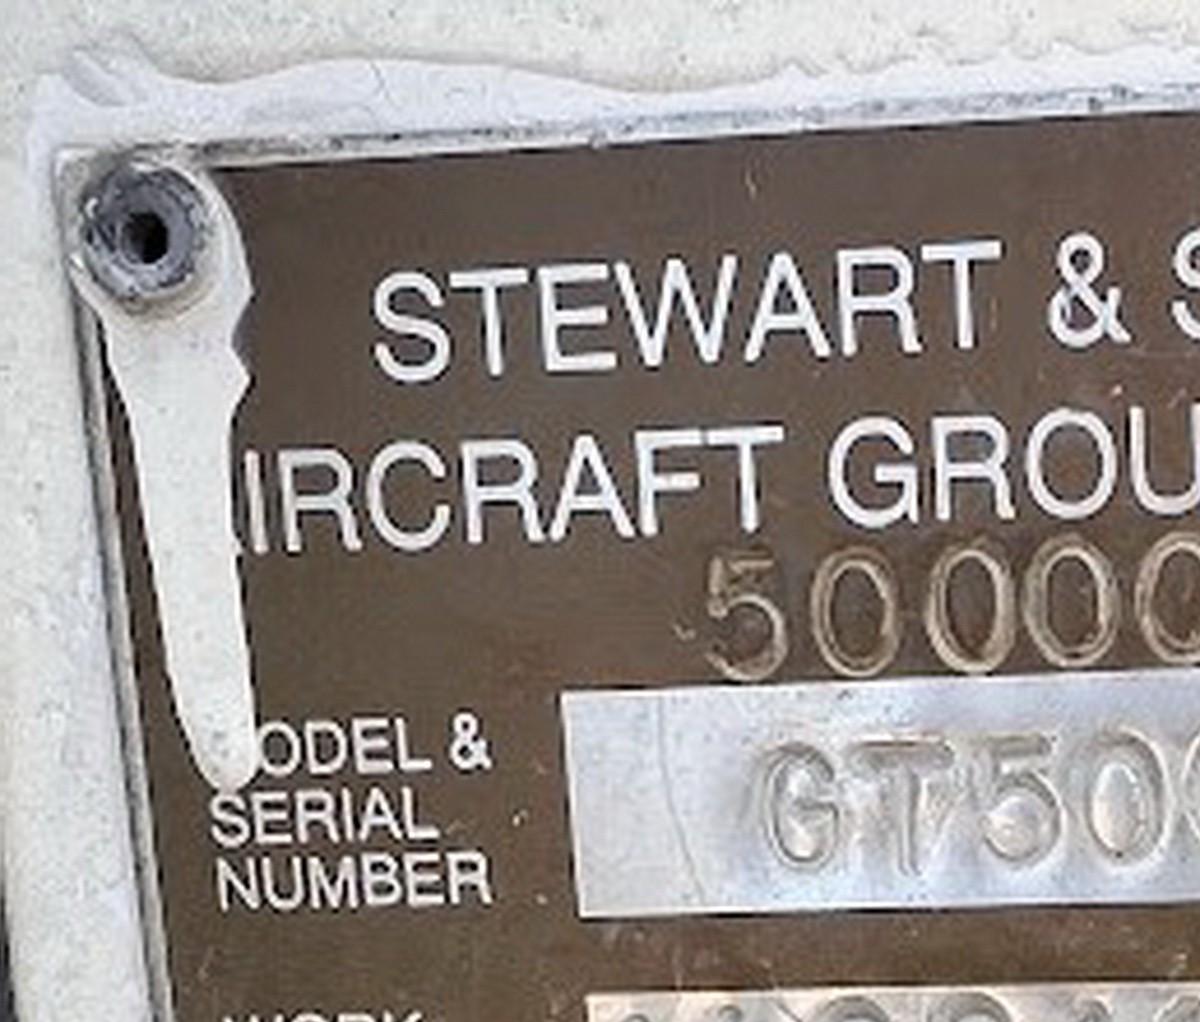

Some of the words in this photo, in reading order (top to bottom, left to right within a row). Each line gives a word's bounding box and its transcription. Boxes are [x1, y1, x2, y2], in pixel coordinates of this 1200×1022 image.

[374, 240, 1001, 382] STEWART
[1048, 232, 1131, 348] &
[243, 425, 785, 553] IRCRAFT
[257, 717, 433, 775] ODEL
[450, 713, 492, 769] &
[210, 789, 440, 847] SERIAL
[217, 847, 492, 911] NUMBER
